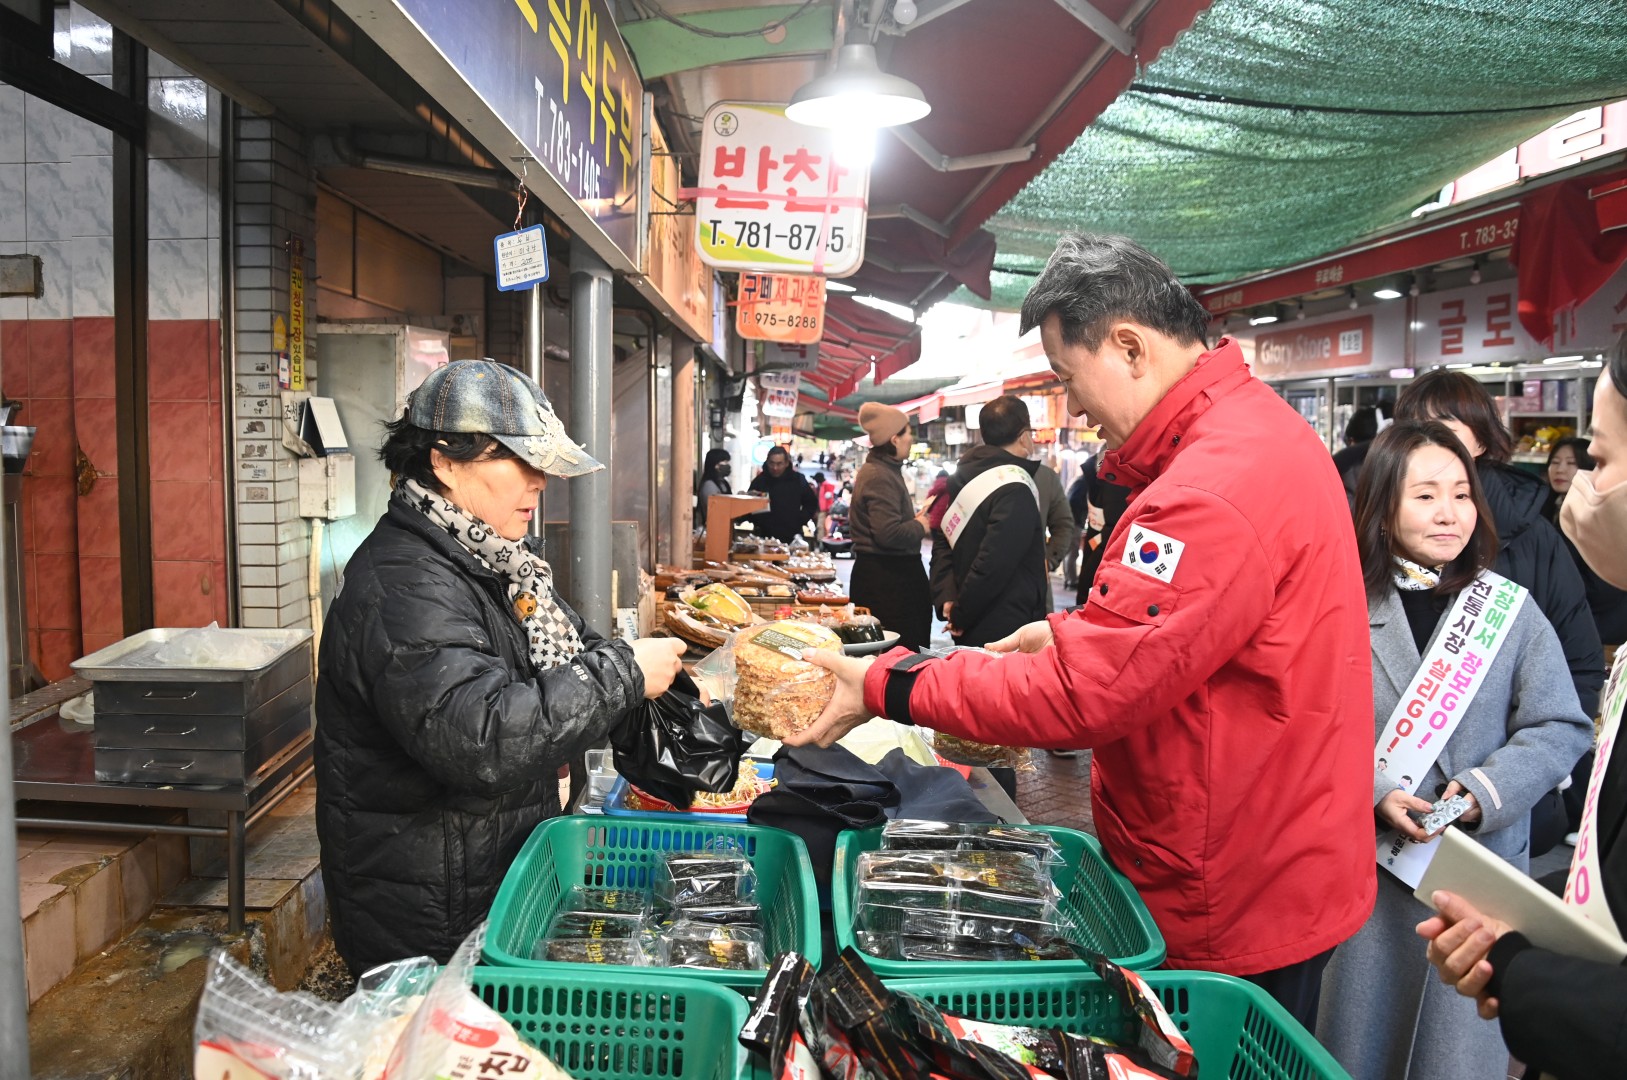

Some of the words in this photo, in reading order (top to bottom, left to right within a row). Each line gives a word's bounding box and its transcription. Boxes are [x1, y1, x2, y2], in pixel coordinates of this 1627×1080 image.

[713, 145, 850, 214] 반찬
[709, 219, 726, 247] T.
[292, 291, 302, 342] 청국장
[755, 312, 817, 329] 975-8288
[292, 344, 302, 385] 있습니다
[1261, 337, 1295, 368] Glory
[1296, 333, 1332, 362] Store
[1443, 578, 1492, 655] 전통시장
[1473, 578, 1520, 650] 시장에서
[1386, 656, 1452, 754] 살리GO!
[1416, 650, 1483, 750] 장보GO!
